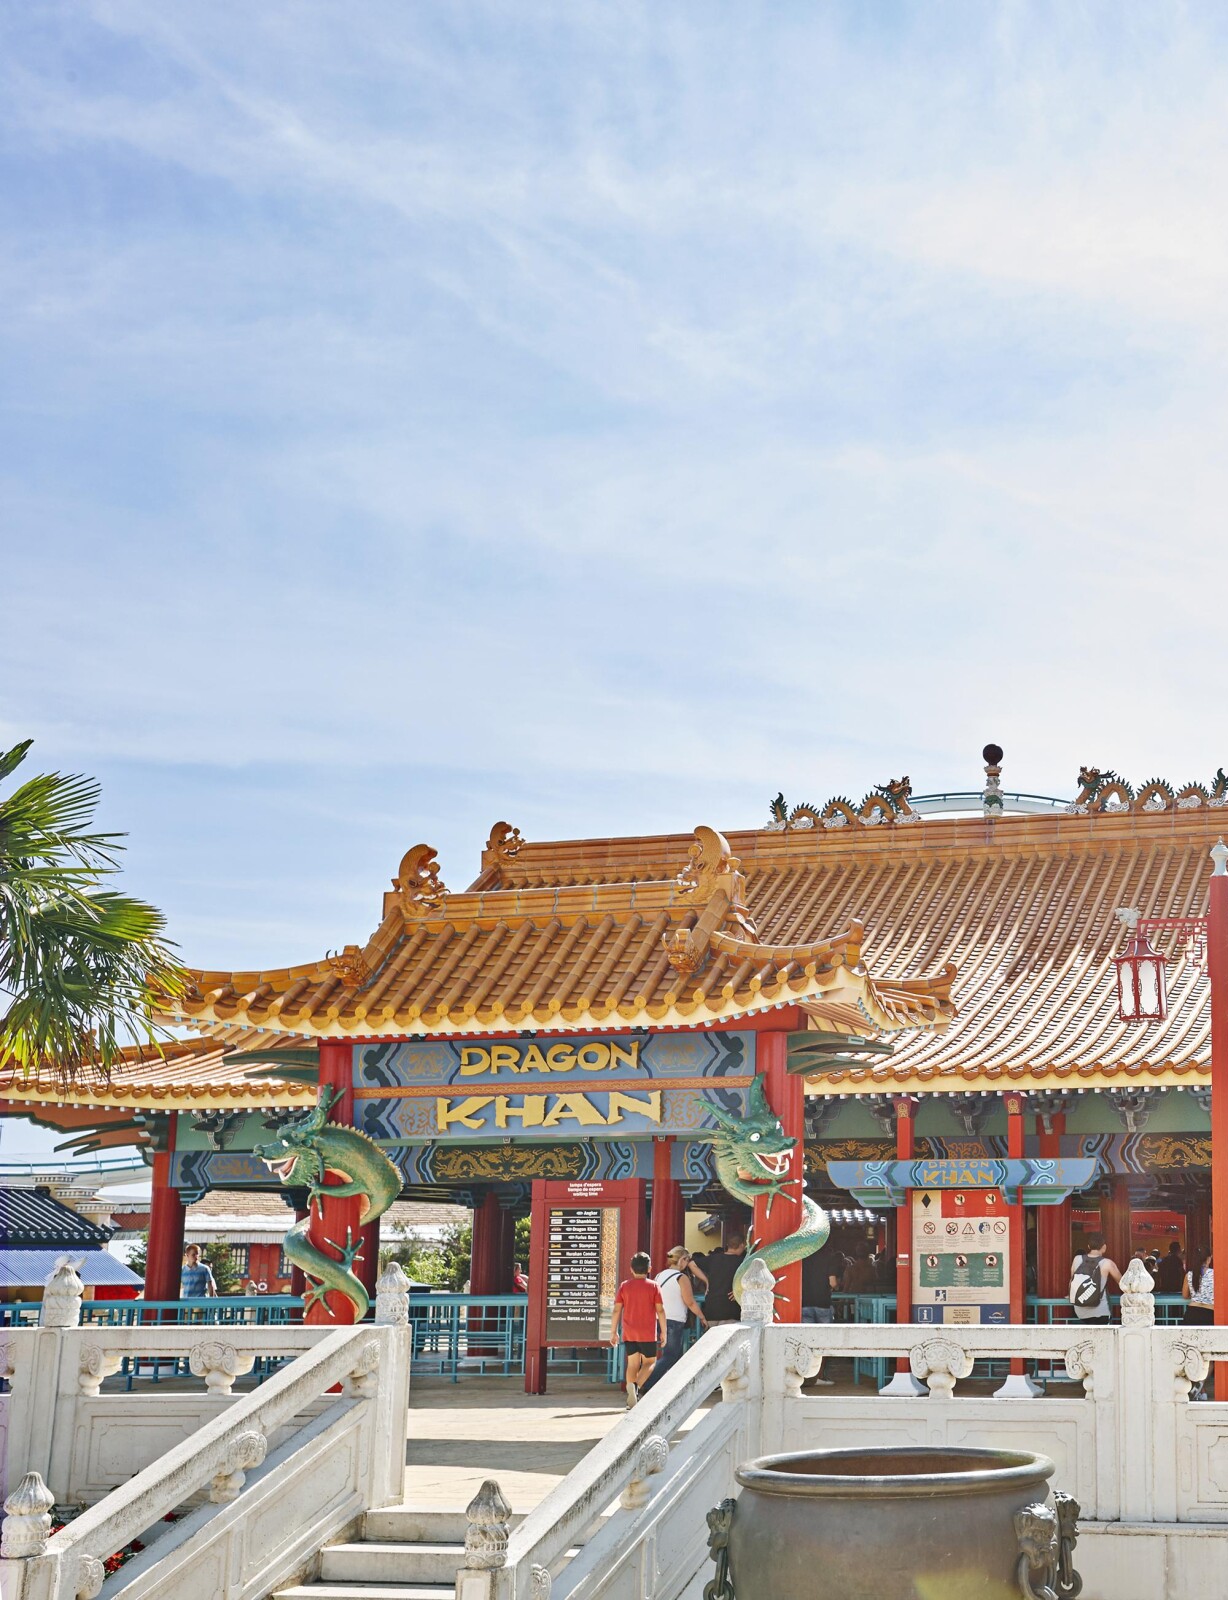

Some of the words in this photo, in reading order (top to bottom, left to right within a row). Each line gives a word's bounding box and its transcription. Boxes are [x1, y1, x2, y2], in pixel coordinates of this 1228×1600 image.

[460, 1041, 639, 1075] DRAGON
[437, 1091, 662, 1131] KHAN
[928, 1161, 989, 1169] DRAGON
[923, 1169, 994, 1185] KHAN
[1078, 1284, 1097, 1304] PUMA
